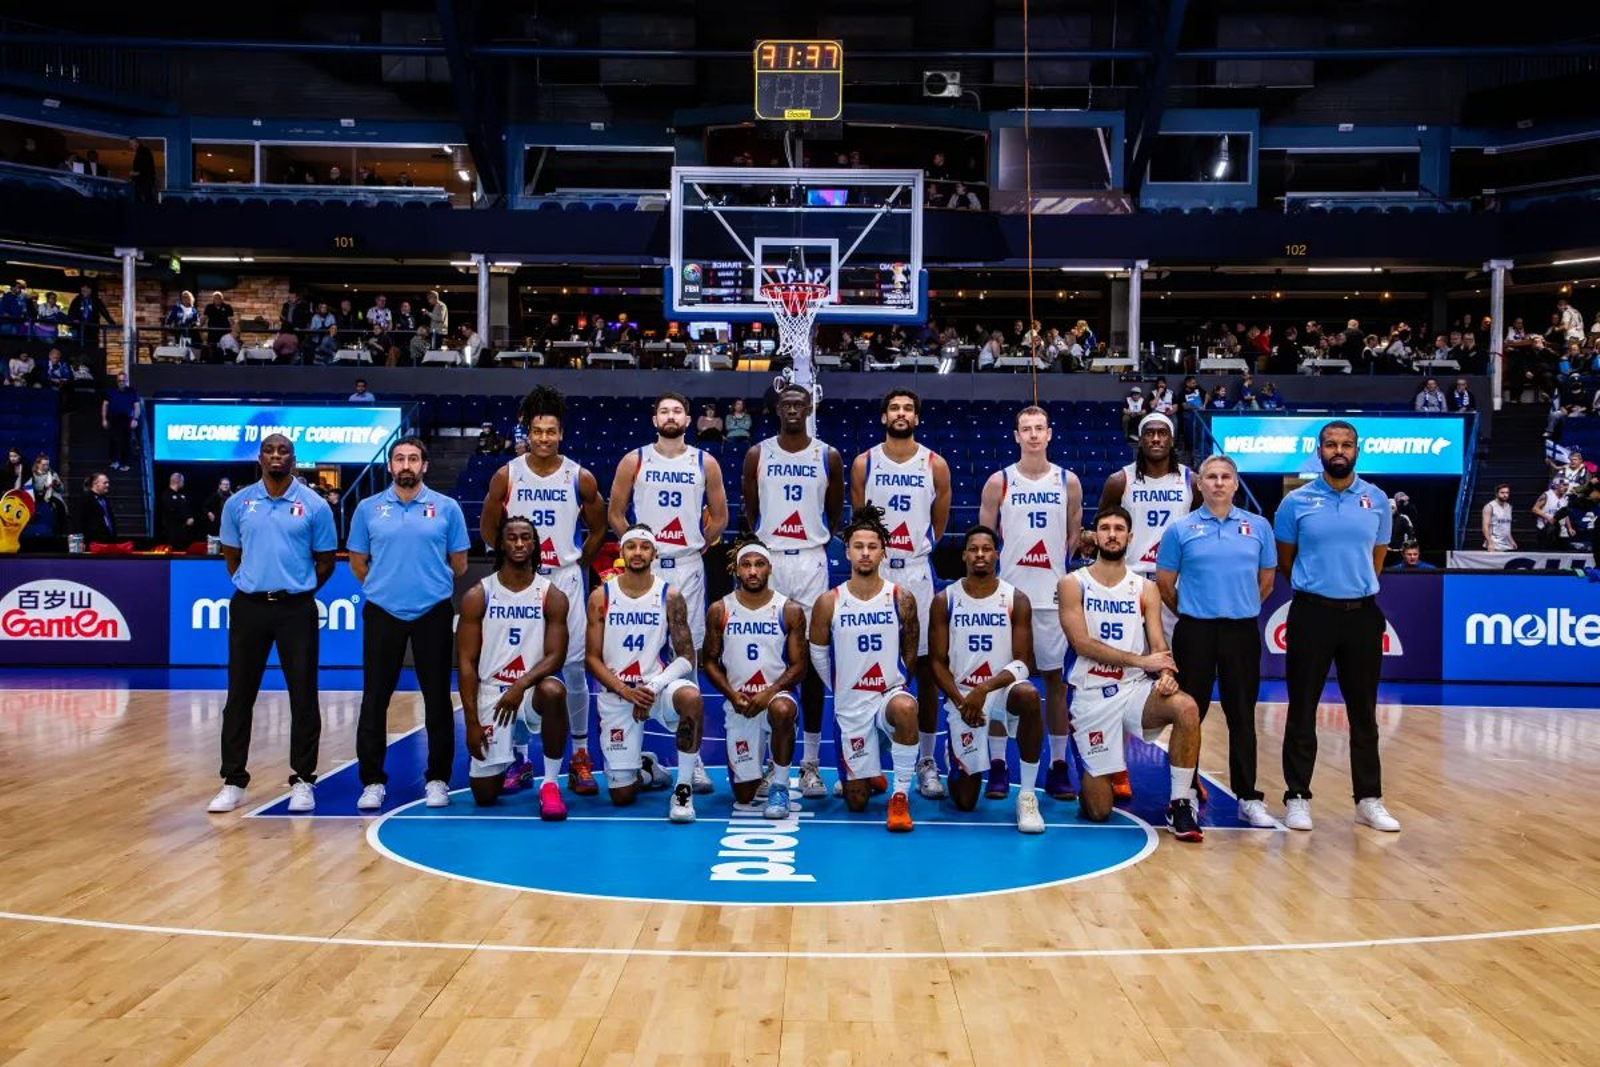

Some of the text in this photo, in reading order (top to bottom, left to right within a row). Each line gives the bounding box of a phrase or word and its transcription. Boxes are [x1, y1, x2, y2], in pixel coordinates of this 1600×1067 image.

[334, 236, 354, 248] 101
[1285, 244, 1307, 256] 102
[167, 425, 242, 442] WELCOME
[244, 425, 259, 442] TO
[305, 426, 372, 444] COUNTRY
[1224, 436, 1433, 454] WELCOME TO COUNTRY
[645, 470, 696, 485] FRANCE
[767, 464, 817, 478] FRANCE
[875, 474, 925, 487] FRANCE
[517, 489, 568, 502] FRANCE
[658, 490, 682, 507] 33
[783, 484, 803, 501] 13
[1011, 492, 1061, 506] FRANCE
[1131, 490, 1184, 503] FRANCE
[888, 494, 911, 511] 45
[532, 510, 555, 526] 35
[1027, 511, 1047, 529] 15
[1147, 510, 1171, 527] 97
[657, 530, 684, 540] MAIF
[778, 524, 804, 533] MAIF
[541, 551, 557, 560] AIF
[1022, 554, 1049, 563] MAIF
[18, 589, 92, 610] 百岁山
[1086, 597, 1136, 614] FRANCE
[489, 606, 542, 619] FRANCE
[608, 612, 660, 626] FRANCE
[839, 611, 894, 628] FRANCE
[954, 613, 1007, 628] FRANCE
[508, 627, 521, 645] 5
[727, 622, 779, 636] FRANCE
[1099, 621, 1123, 640] 95
[622, 634, 645, 652] 44
[857, 633, 883, 652] 85
[968, 634, 993, 652] 55
[746, 643, 759, 661] 6
[741, 683, 769, 693] MAIF
[858, 676, 885, 687] MAIF
